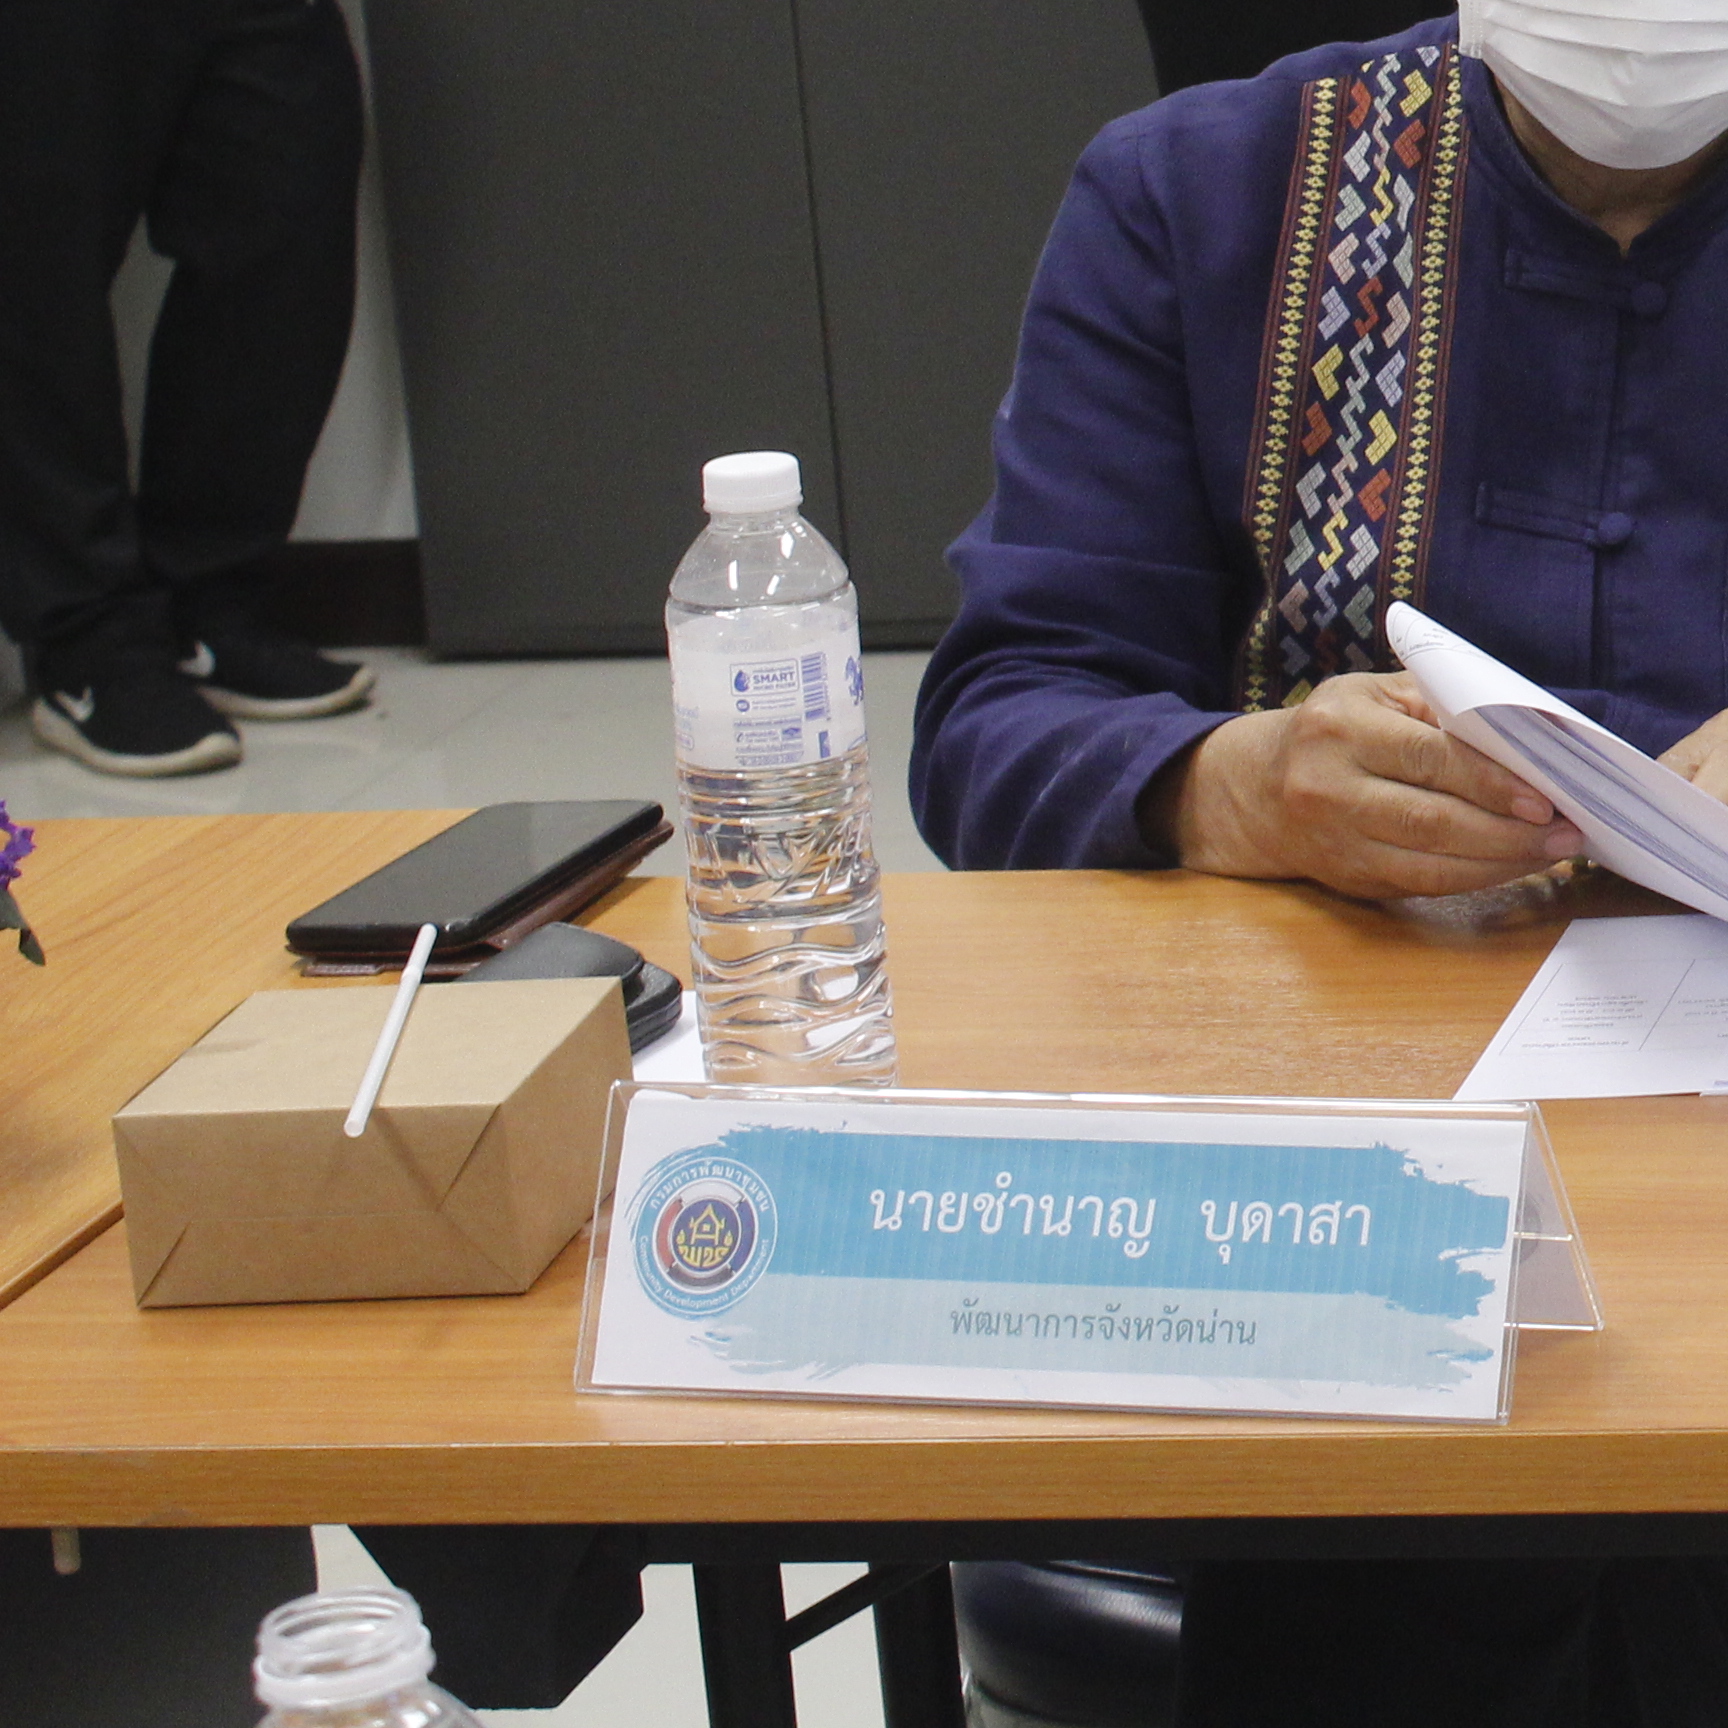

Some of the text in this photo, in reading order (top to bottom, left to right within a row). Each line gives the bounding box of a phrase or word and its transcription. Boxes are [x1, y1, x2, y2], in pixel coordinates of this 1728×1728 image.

[752, 671, 796, 685] SMART
[650, 1159, 771, 1213] กรมการพัฒนาชุมชน
[868, 1170, 1373, 1265] นายชำนาญ บุดาสา
[640, 1235, 771, 1310] Community Development Department
[949, 1297, 1258, 1347] พัฒนาการจังหวัดน่าน
